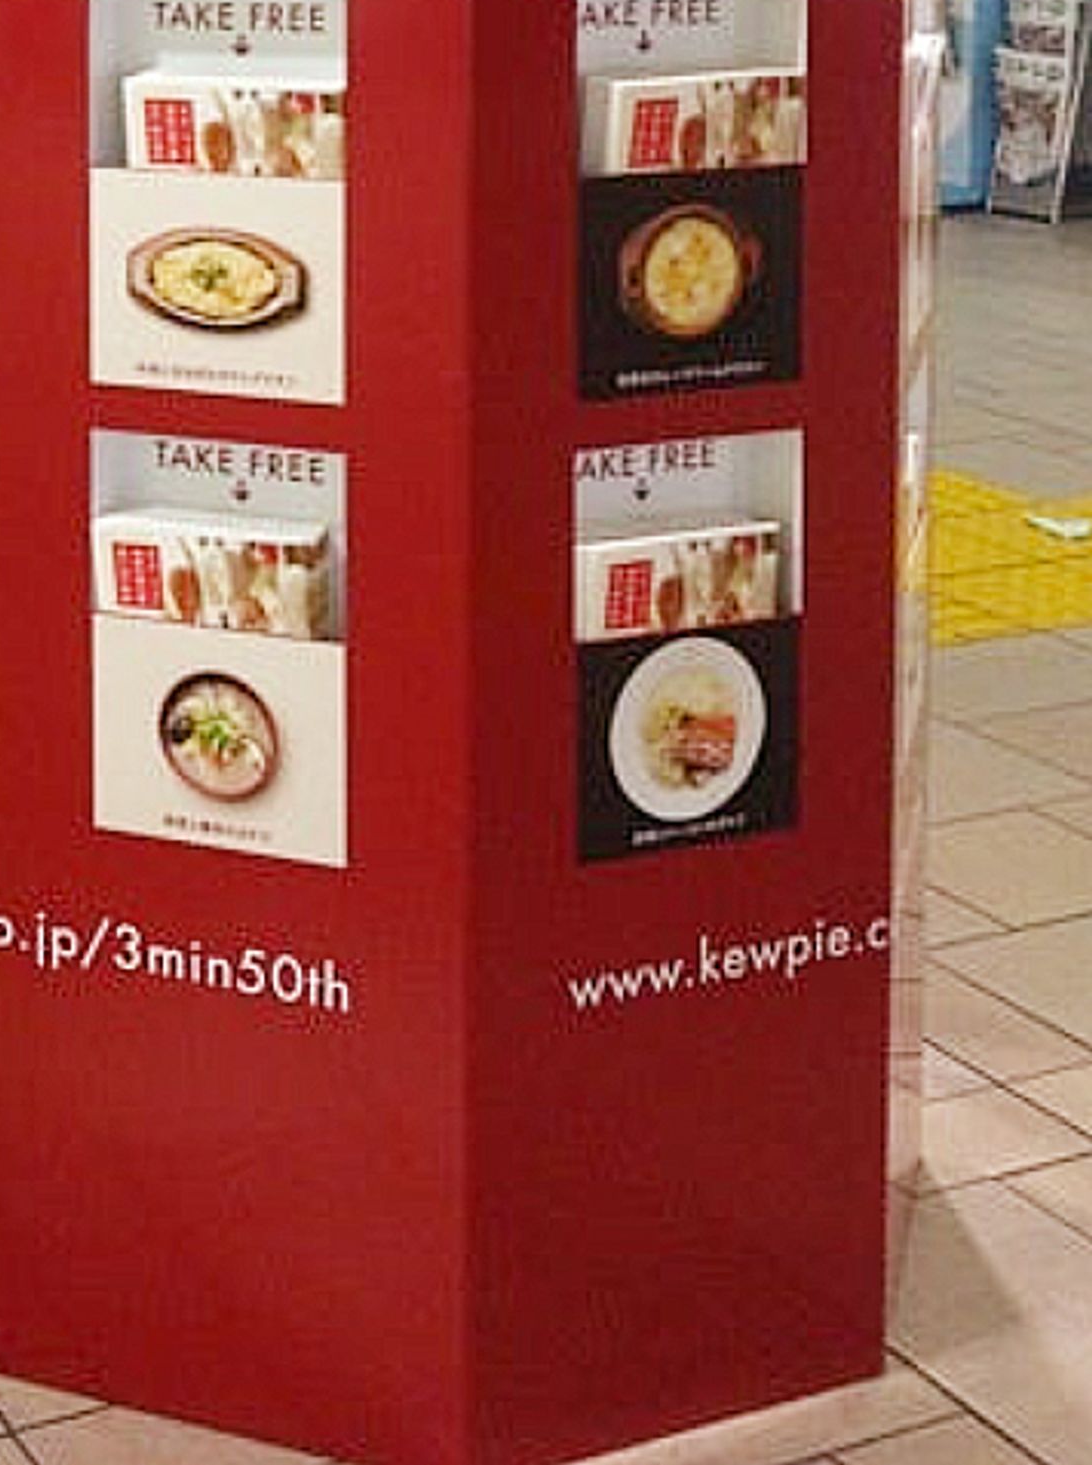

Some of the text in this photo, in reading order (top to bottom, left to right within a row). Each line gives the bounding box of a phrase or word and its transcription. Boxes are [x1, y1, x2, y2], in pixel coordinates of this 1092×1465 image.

[153, 1, 327, 33] TAKE FREE
[153, 440, 326, 486] TAKE FREE
[651, 443, 718, 475] FREE
[566, 917, 890, 1011] www.kewpie.c
